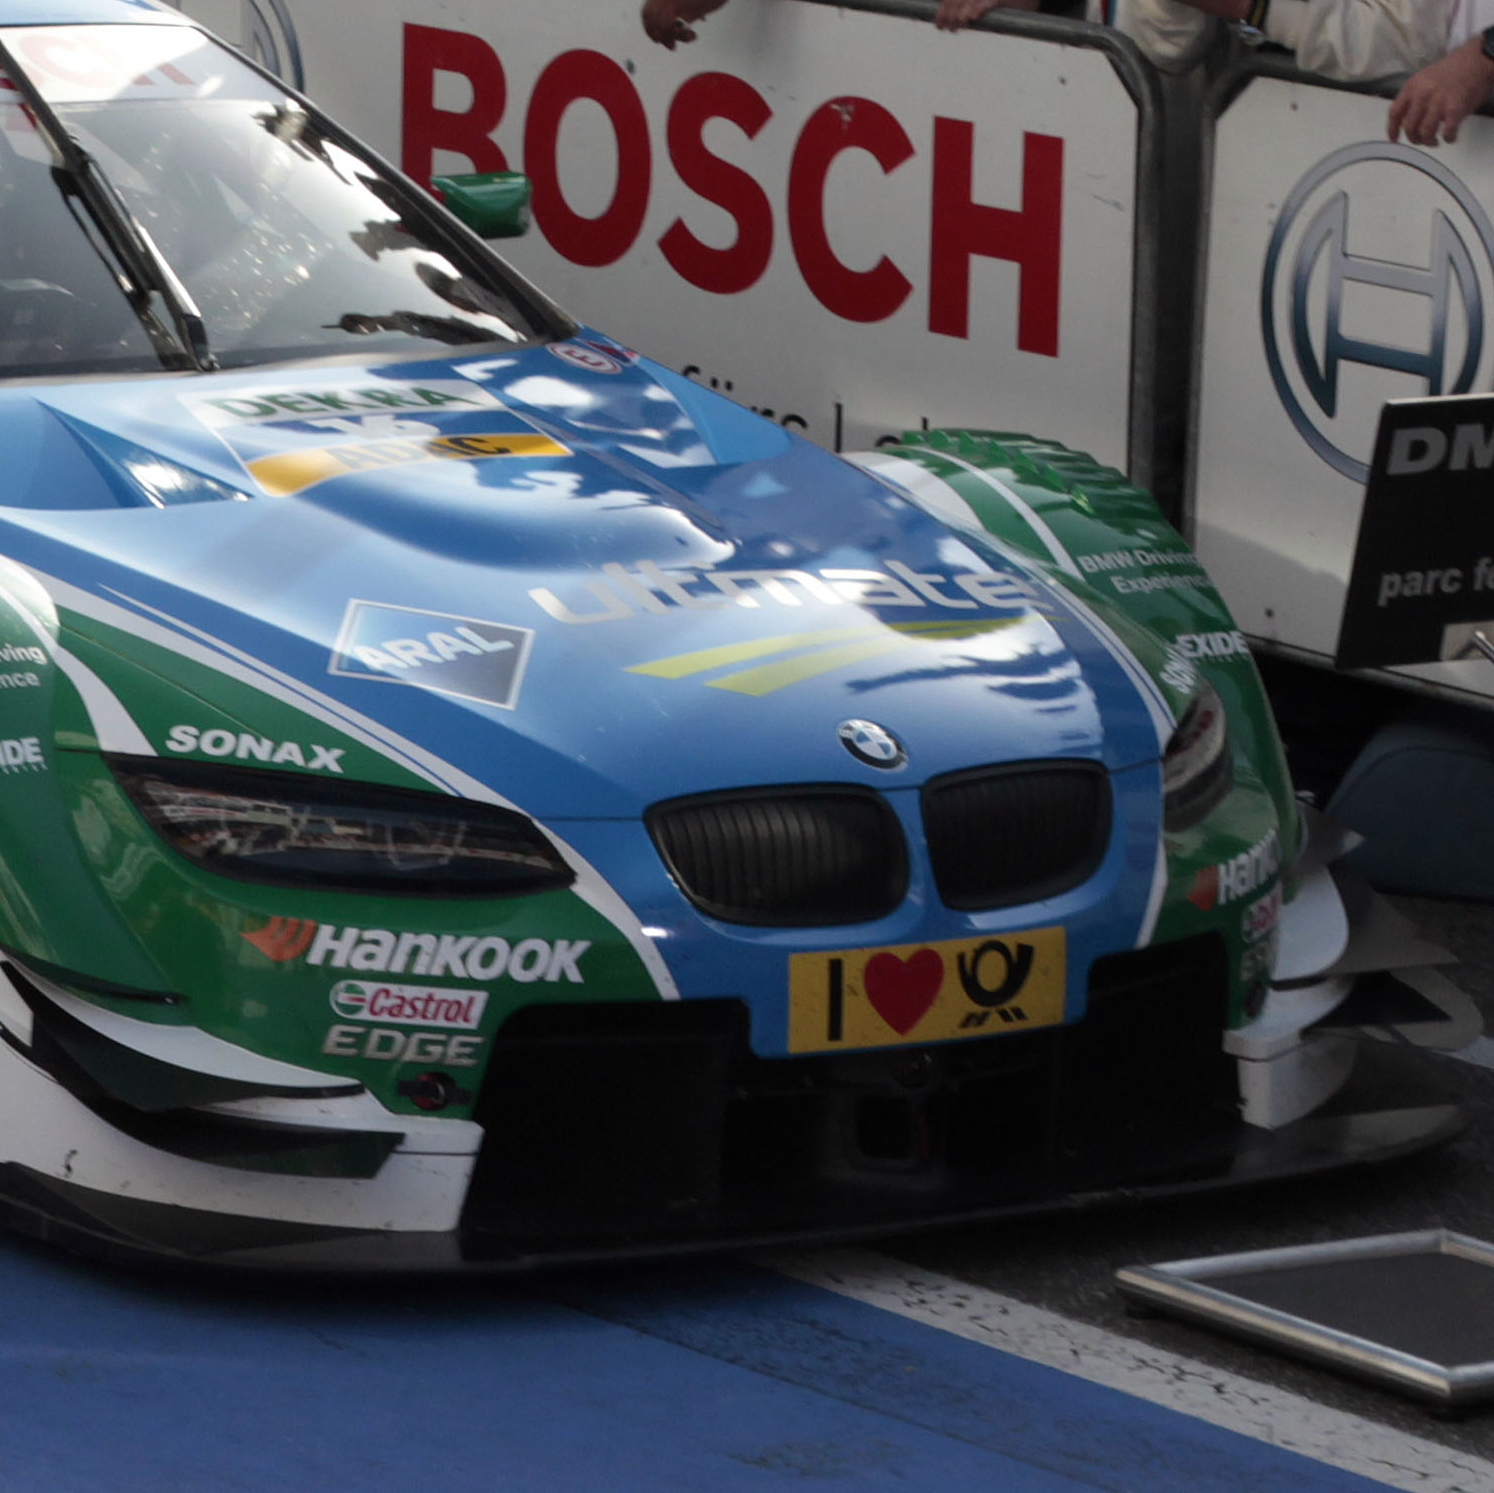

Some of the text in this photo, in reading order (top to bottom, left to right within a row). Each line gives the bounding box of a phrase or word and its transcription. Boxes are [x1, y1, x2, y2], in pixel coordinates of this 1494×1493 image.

[401, 21, 1064, 358] BOSCH
[214, 385, 481, 418] DEKRA
[526, 561, 1042, 625] ultimate
[1378, 568, 1463, 609] parc
[356, 623, 516, 675] ARAL
[164, 724, 348, 774] SONAX
[366, 986, 475, 1027] Castrol
[825, 957, 844, 1042] I
[321, 1025, 484, 1068] EDGE
